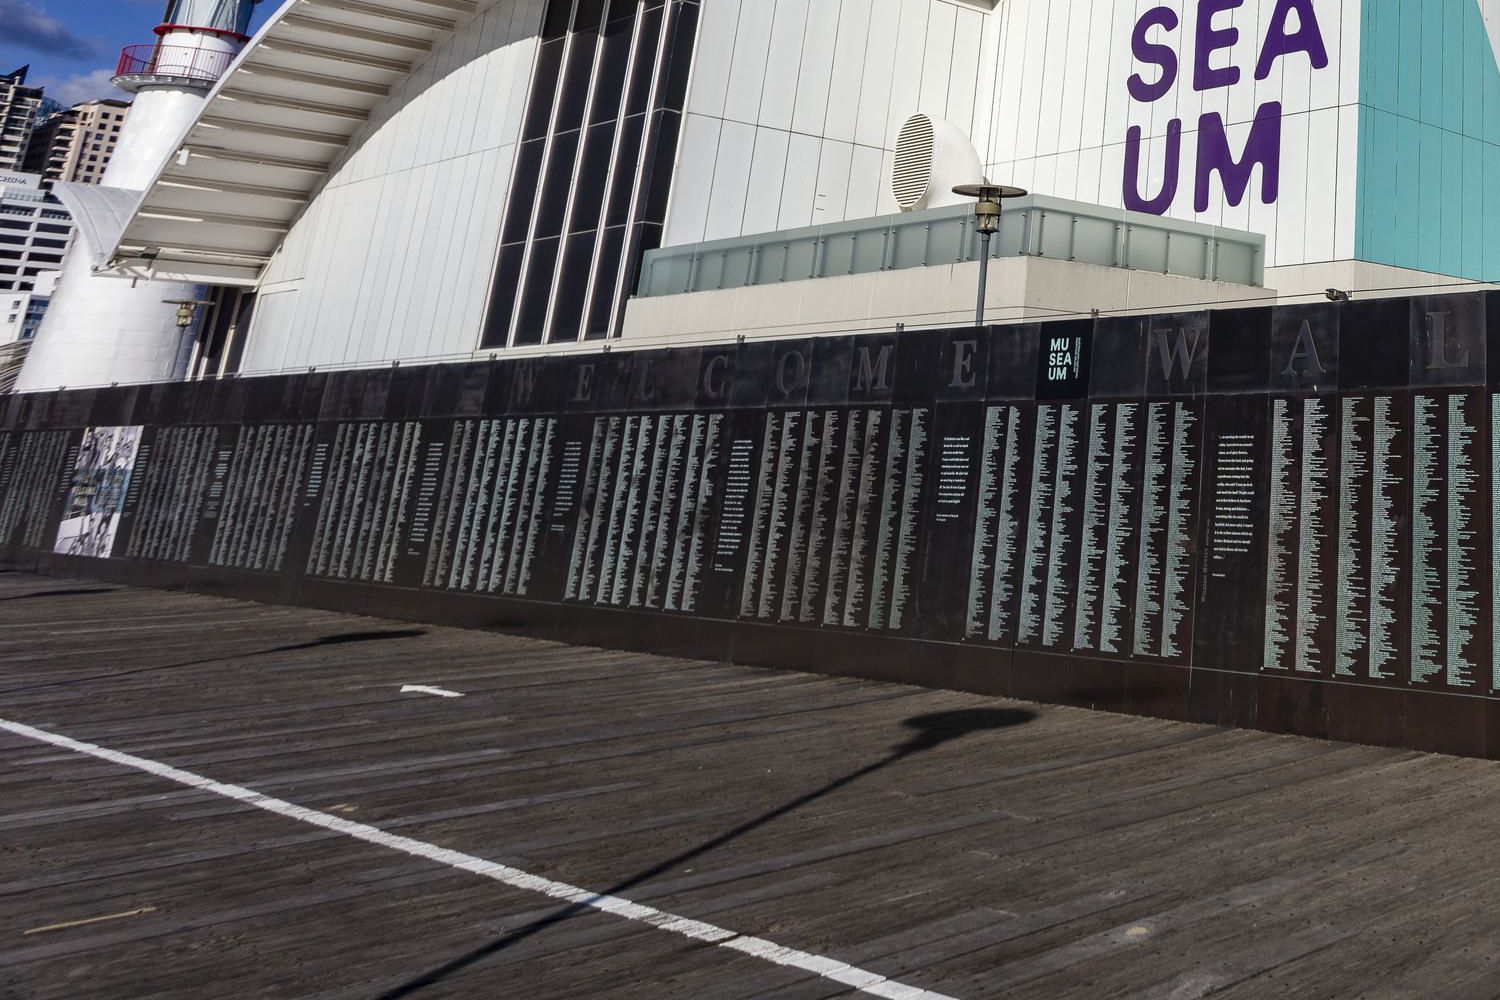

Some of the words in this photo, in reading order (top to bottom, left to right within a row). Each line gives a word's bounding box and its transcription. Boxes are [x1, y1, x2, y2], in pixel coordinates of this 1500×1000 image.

[1123, 100, 1282, 216] UM
[1050, 338, 1069, 351] MU
[1049, 352, 1072, 366] SEA
[1048, 367, 1067, 381] UM
